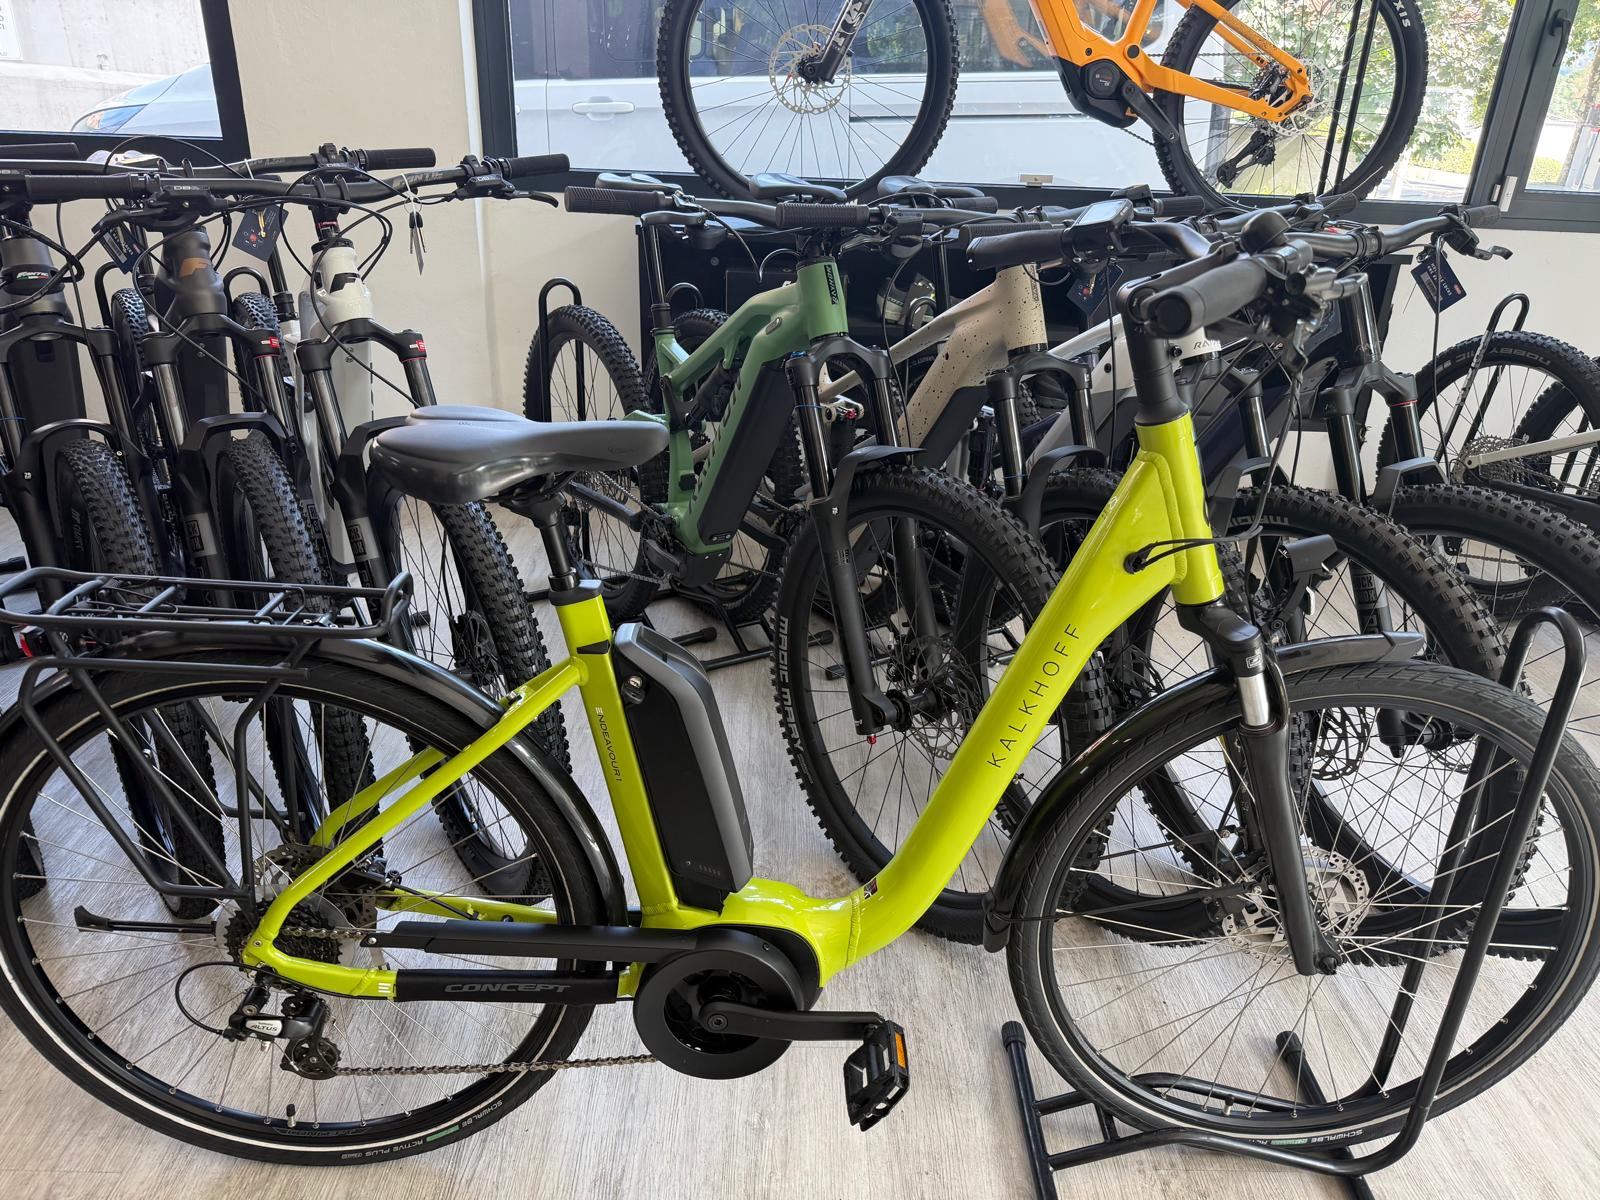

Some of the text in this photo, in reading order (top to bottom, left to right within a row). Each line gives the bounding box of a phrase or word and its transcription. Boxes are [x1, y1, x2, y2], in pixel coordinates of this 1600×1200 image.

[778, 615, 804, 752] MAGIC MARY
[986, 623, 1080, 768] KALKHOFF
[595, 706, 621, 777] ENDEAVOUR
[445, 983, 571, 992] CONCEPT
[461, 1099, 503, 1128] SCHWALBE
[392, 1139, 424, 1152] ACTIVE
[1310, 1129, 1363, 1144] SCHWALBE
[365, 1148, 391, 1157] PLUS
